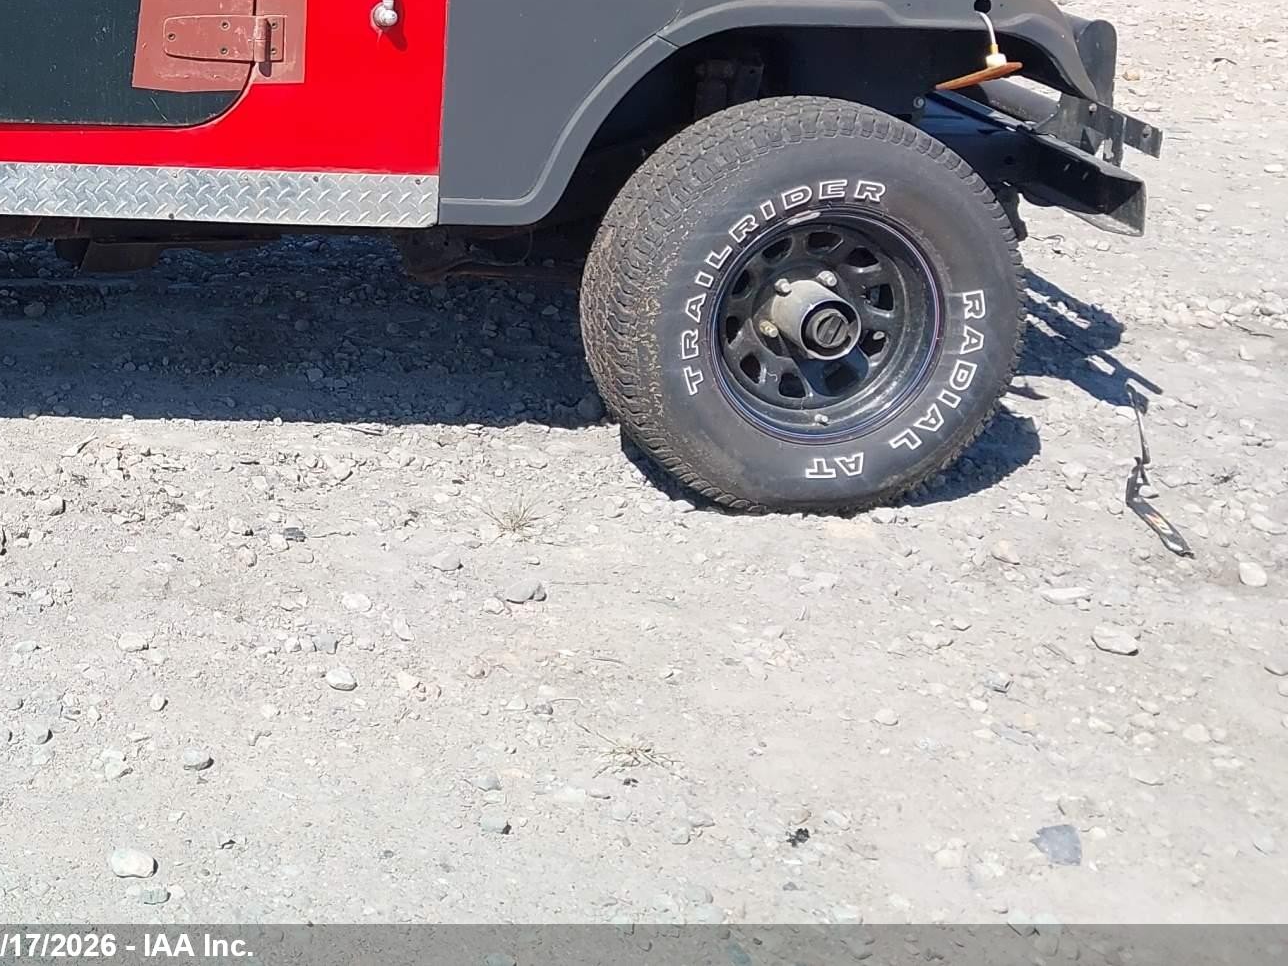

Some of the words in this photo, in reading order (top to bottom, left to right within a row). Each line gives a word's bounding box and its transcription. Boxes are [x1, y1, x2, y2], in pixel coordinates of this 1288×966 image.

[681, 180, 886, 396] TRAILRIDER
[889, 289, 986, 451] RADIAL
[805, 452, 864, 479] AT
